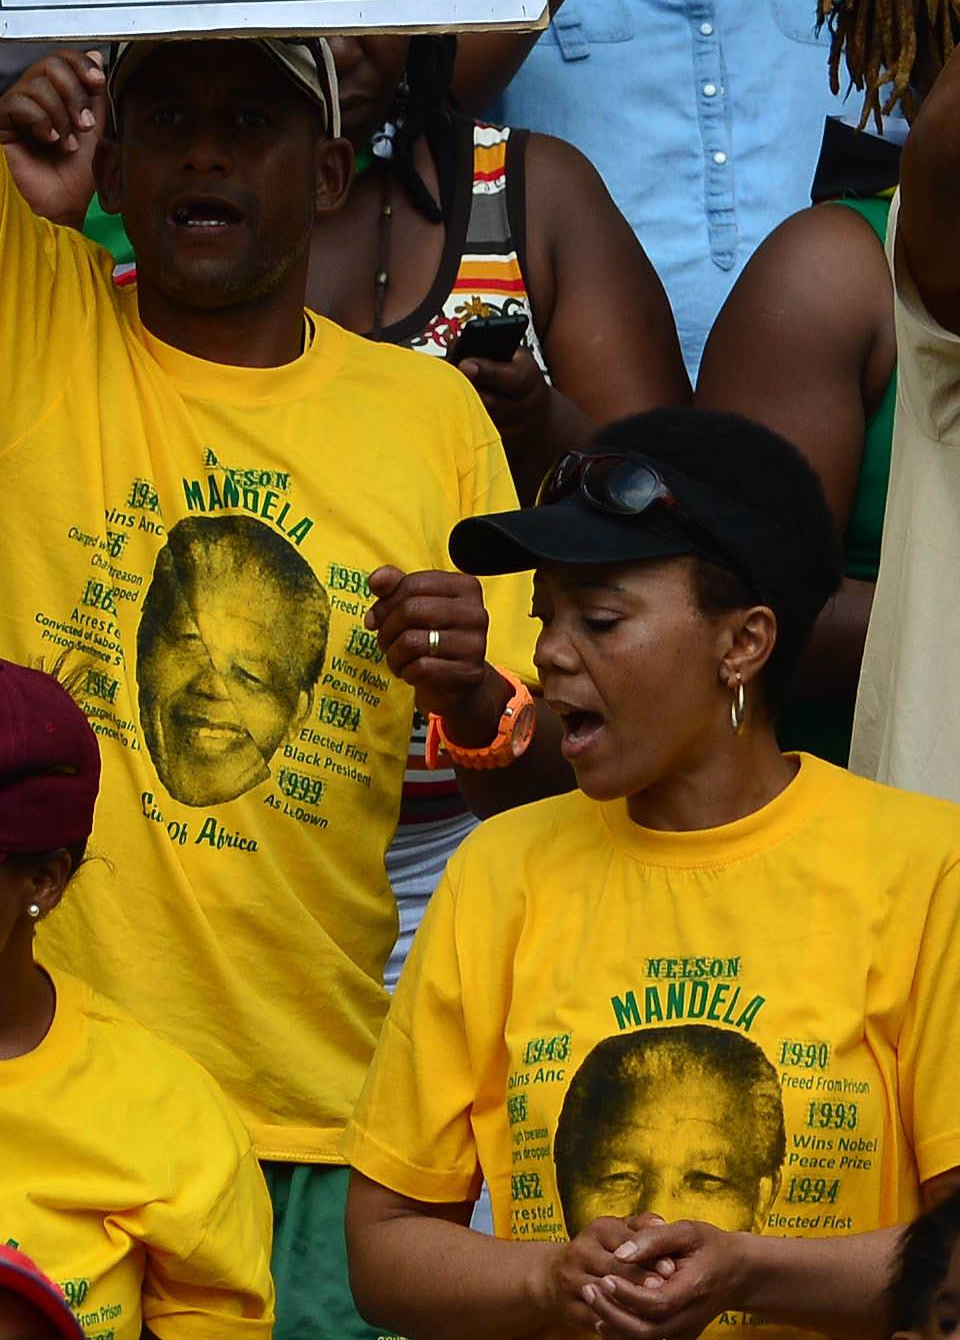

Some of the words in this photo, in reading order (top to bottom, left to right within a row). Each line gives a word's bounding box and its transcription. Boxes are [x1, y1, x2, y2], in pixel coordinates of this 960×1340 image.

[126, 480, 162, 512] 194
[181, 473, 314, 547] MANDELA
[138, 515, 165, 536] Anc
[70, 608, 121, 640] Arreste
[331, 656, 358, 678] Wins
[319, 696, 362, 732] 1994
[299, 728, 344, 754] Elected
[345, 745, 369, 765] First
[283, 745, 321, 767] Black
[324, 757, 373, 788] President
[277, 768, 324, 806] 1999
[263, 794, 282, 810] As
[167, 820, 188, 845] Of
[195, 817, 259, 852] Africa
[646, 957, 741, 979] NELSON
[611, 980, 767, 1032] MANDELA
[524, 1035, 570, 1065] 1943
[779, 1041, 829, 1069] 1990
[533, 1068, 566, 1084] Anc
[781, 1072, 815, 1090] Freed
[815, 1075, 842, 1092] From
[806, 1101, 858, 1129] 1993
[793, 1133, 834, 1150] Wins
[838, 1137, 878, 1153] Nobel
[788, 1152, 836, 1169] Peace
[839, 1155, 872, 1170] Prize
[785, 1176, 840, 1204] 1994
[767, 1213, 820, 1229] Elected
[822, 1215, 853, 1229] First
